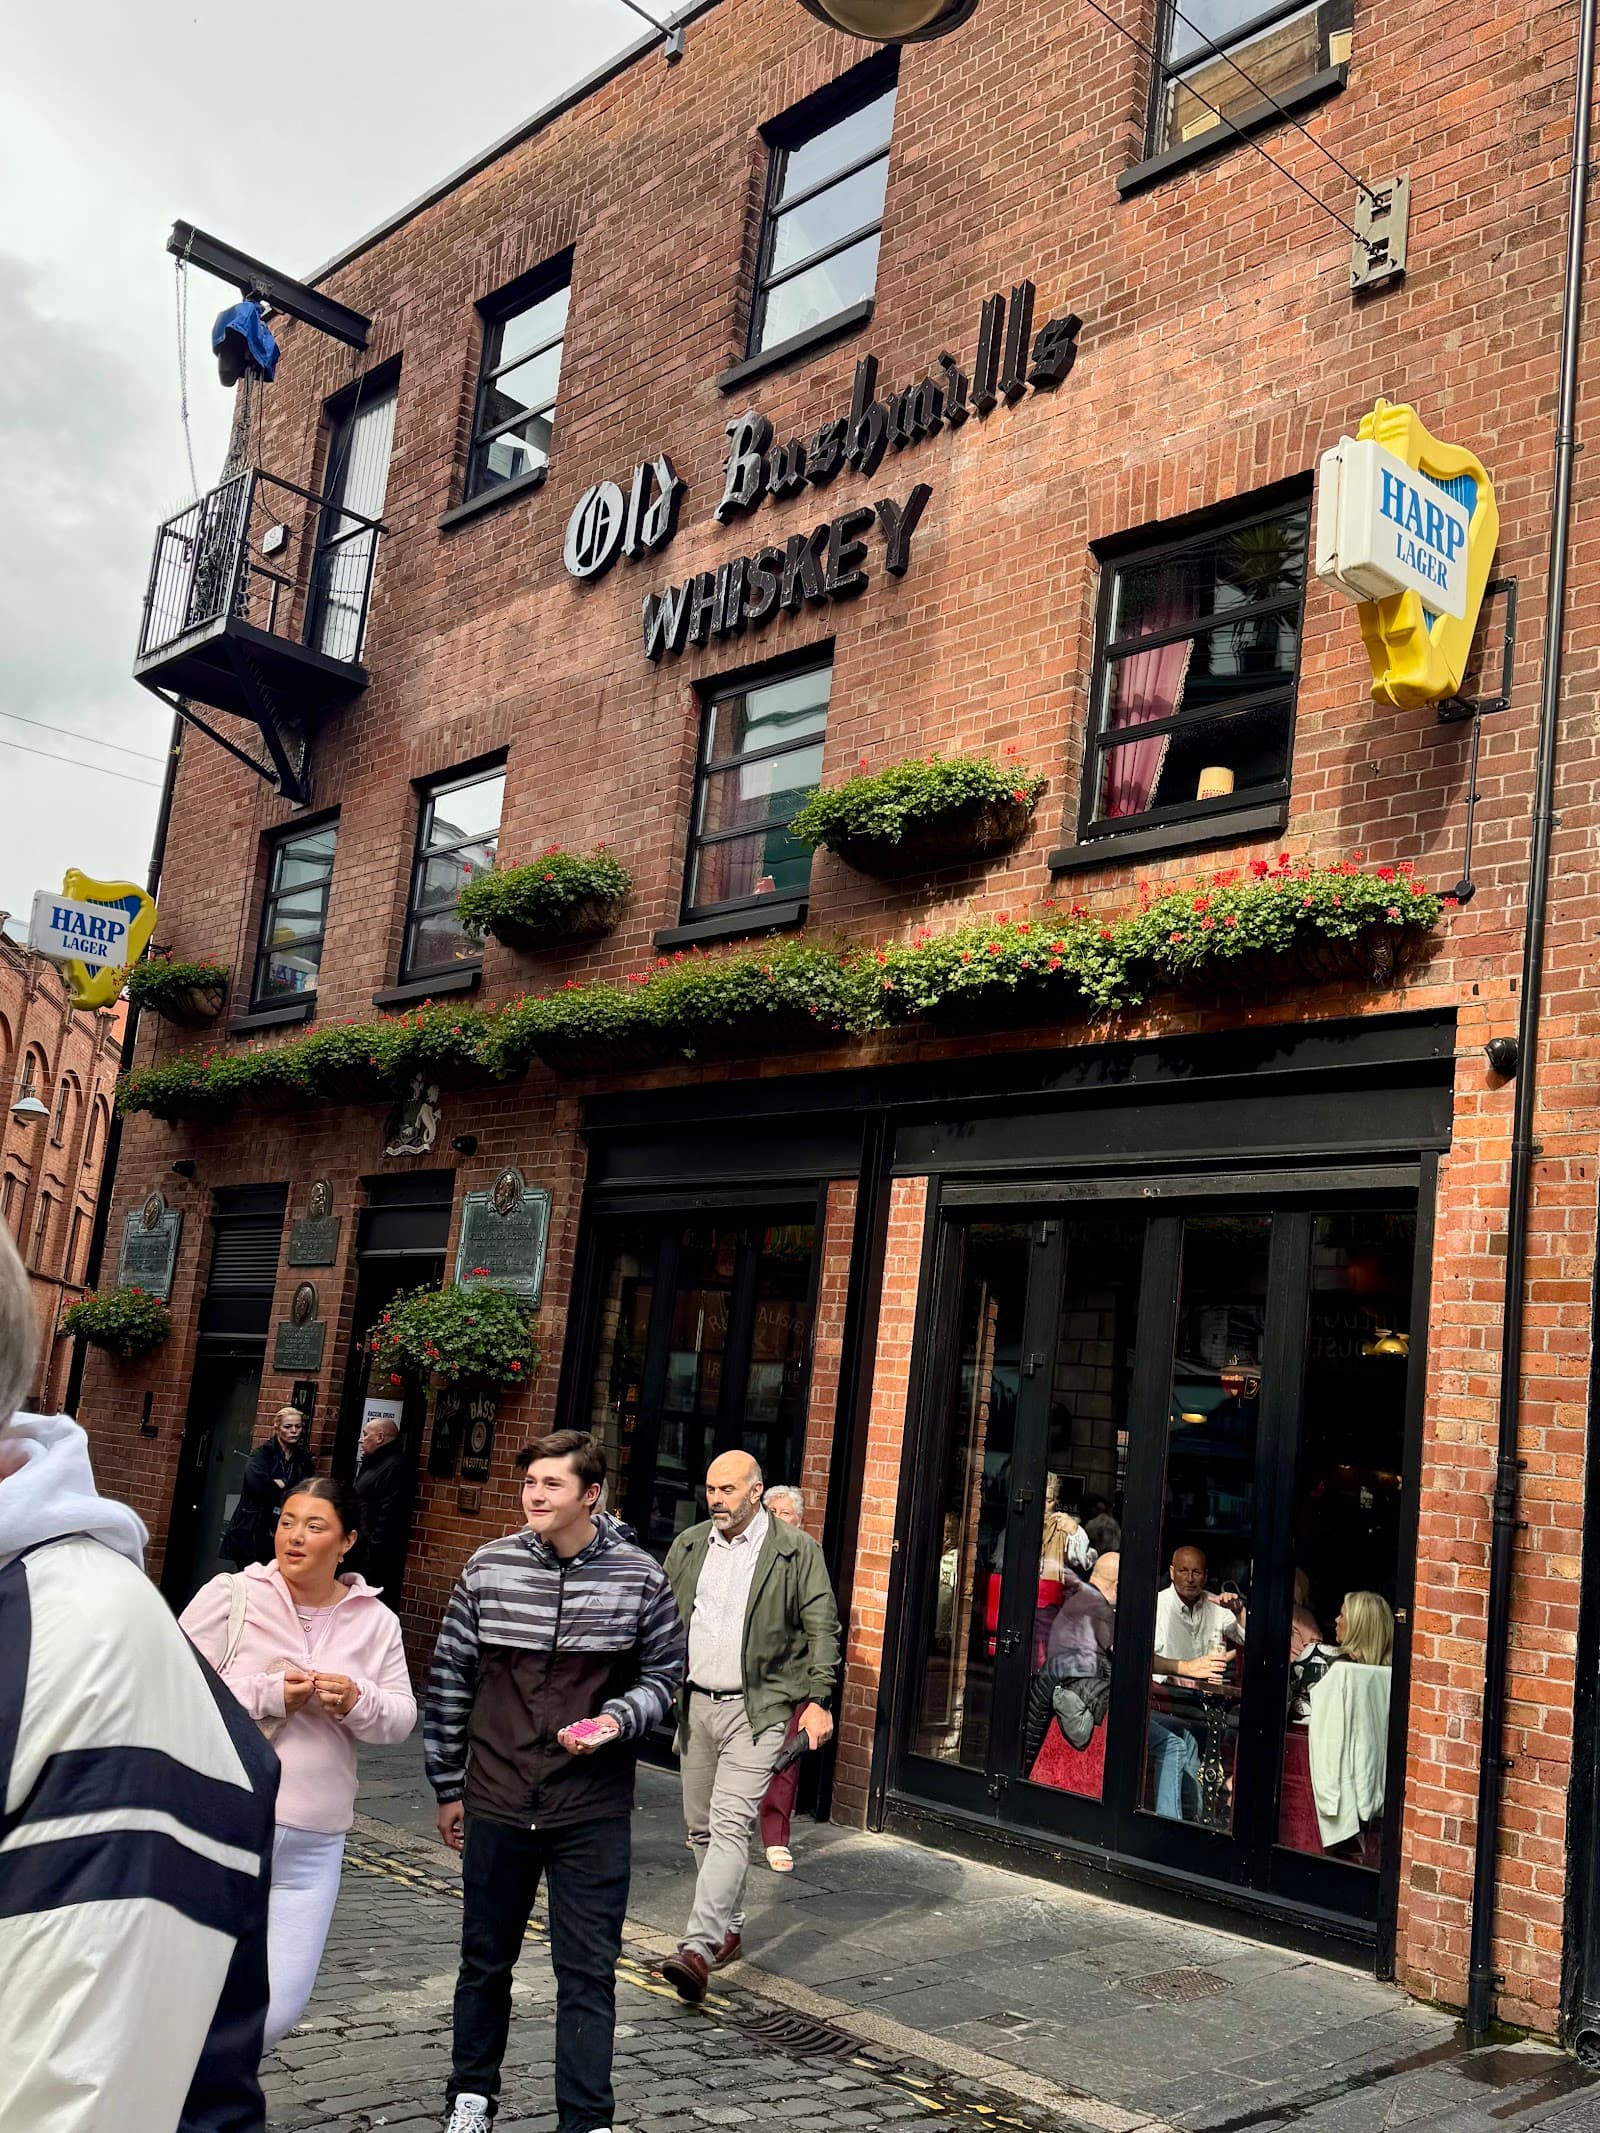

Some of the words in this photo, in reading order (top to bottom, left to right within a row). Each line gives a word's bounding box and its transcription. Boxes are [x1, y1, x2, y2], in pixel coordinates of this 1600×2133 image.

[563, 453, 688, 579] Old
[713, 279, 1083, 524] Bushmills
[1380, 467, 1465, 564] HARP
[642, 483, 933, 662] WHISKEY
[1396, 532, 1448, 591] LAGER
[49, 906, 125, 944] HARP
[62, 935, 108, 957] LAGER
[469, 1400, 496, 1421] BASS
